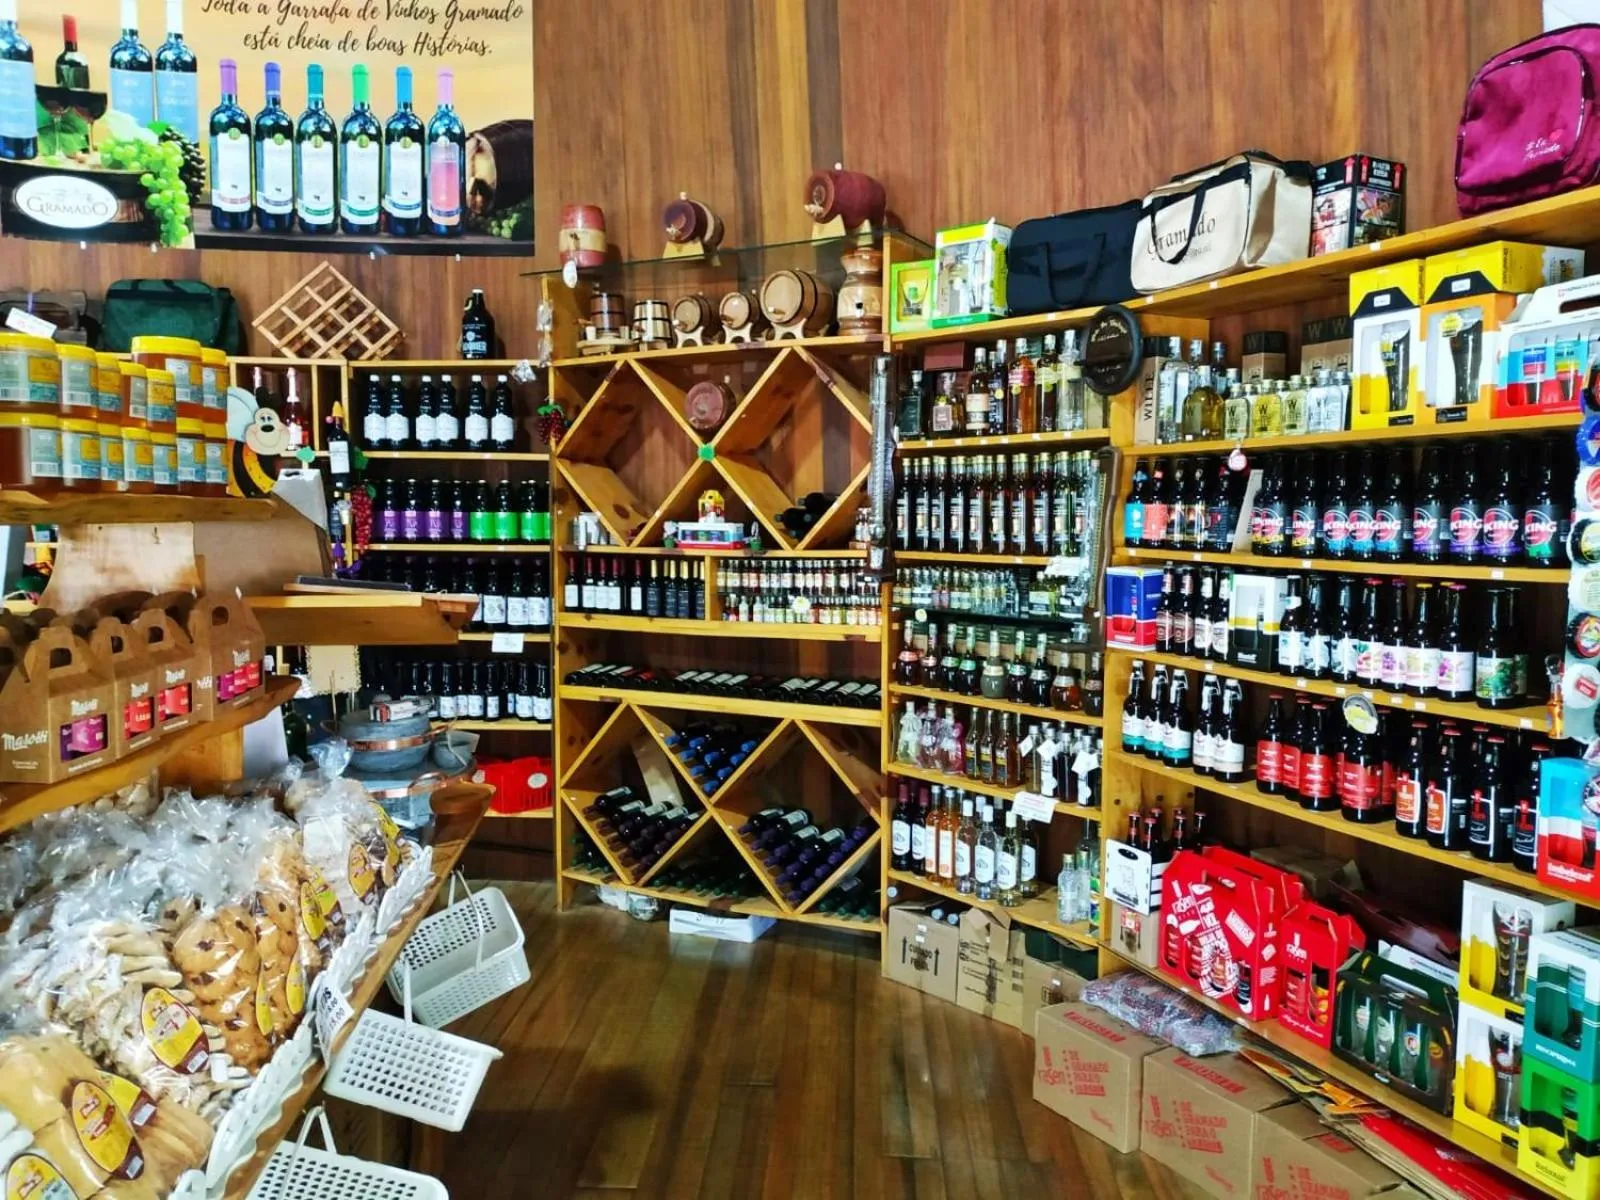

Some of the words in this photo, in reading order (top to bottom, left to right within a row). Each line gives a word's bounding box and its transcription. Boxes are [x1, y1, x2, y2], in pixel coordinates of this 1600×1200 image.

[201, 0, 250, 14] Toda
[257, 2, 270, 15] a
[277, 0, 350, 26] Garrafa
[356, 0, 380, 21] de
[386, 0, 439, 24] Vinhos
[444, 0, 523, 31] Gramado
[243, 25, 281, 50] está
[288, 21, 331, 50] cheia
[338, 30, 361, 52] de
[366, 25, 407, 56] boas
[413, 31, 492, 56] Histórias.
[27, 196, 109, 217] GRAMADO
[1147, 211, 1217, 255] Gramdo
[1484, 519, 1520, 533] KING
